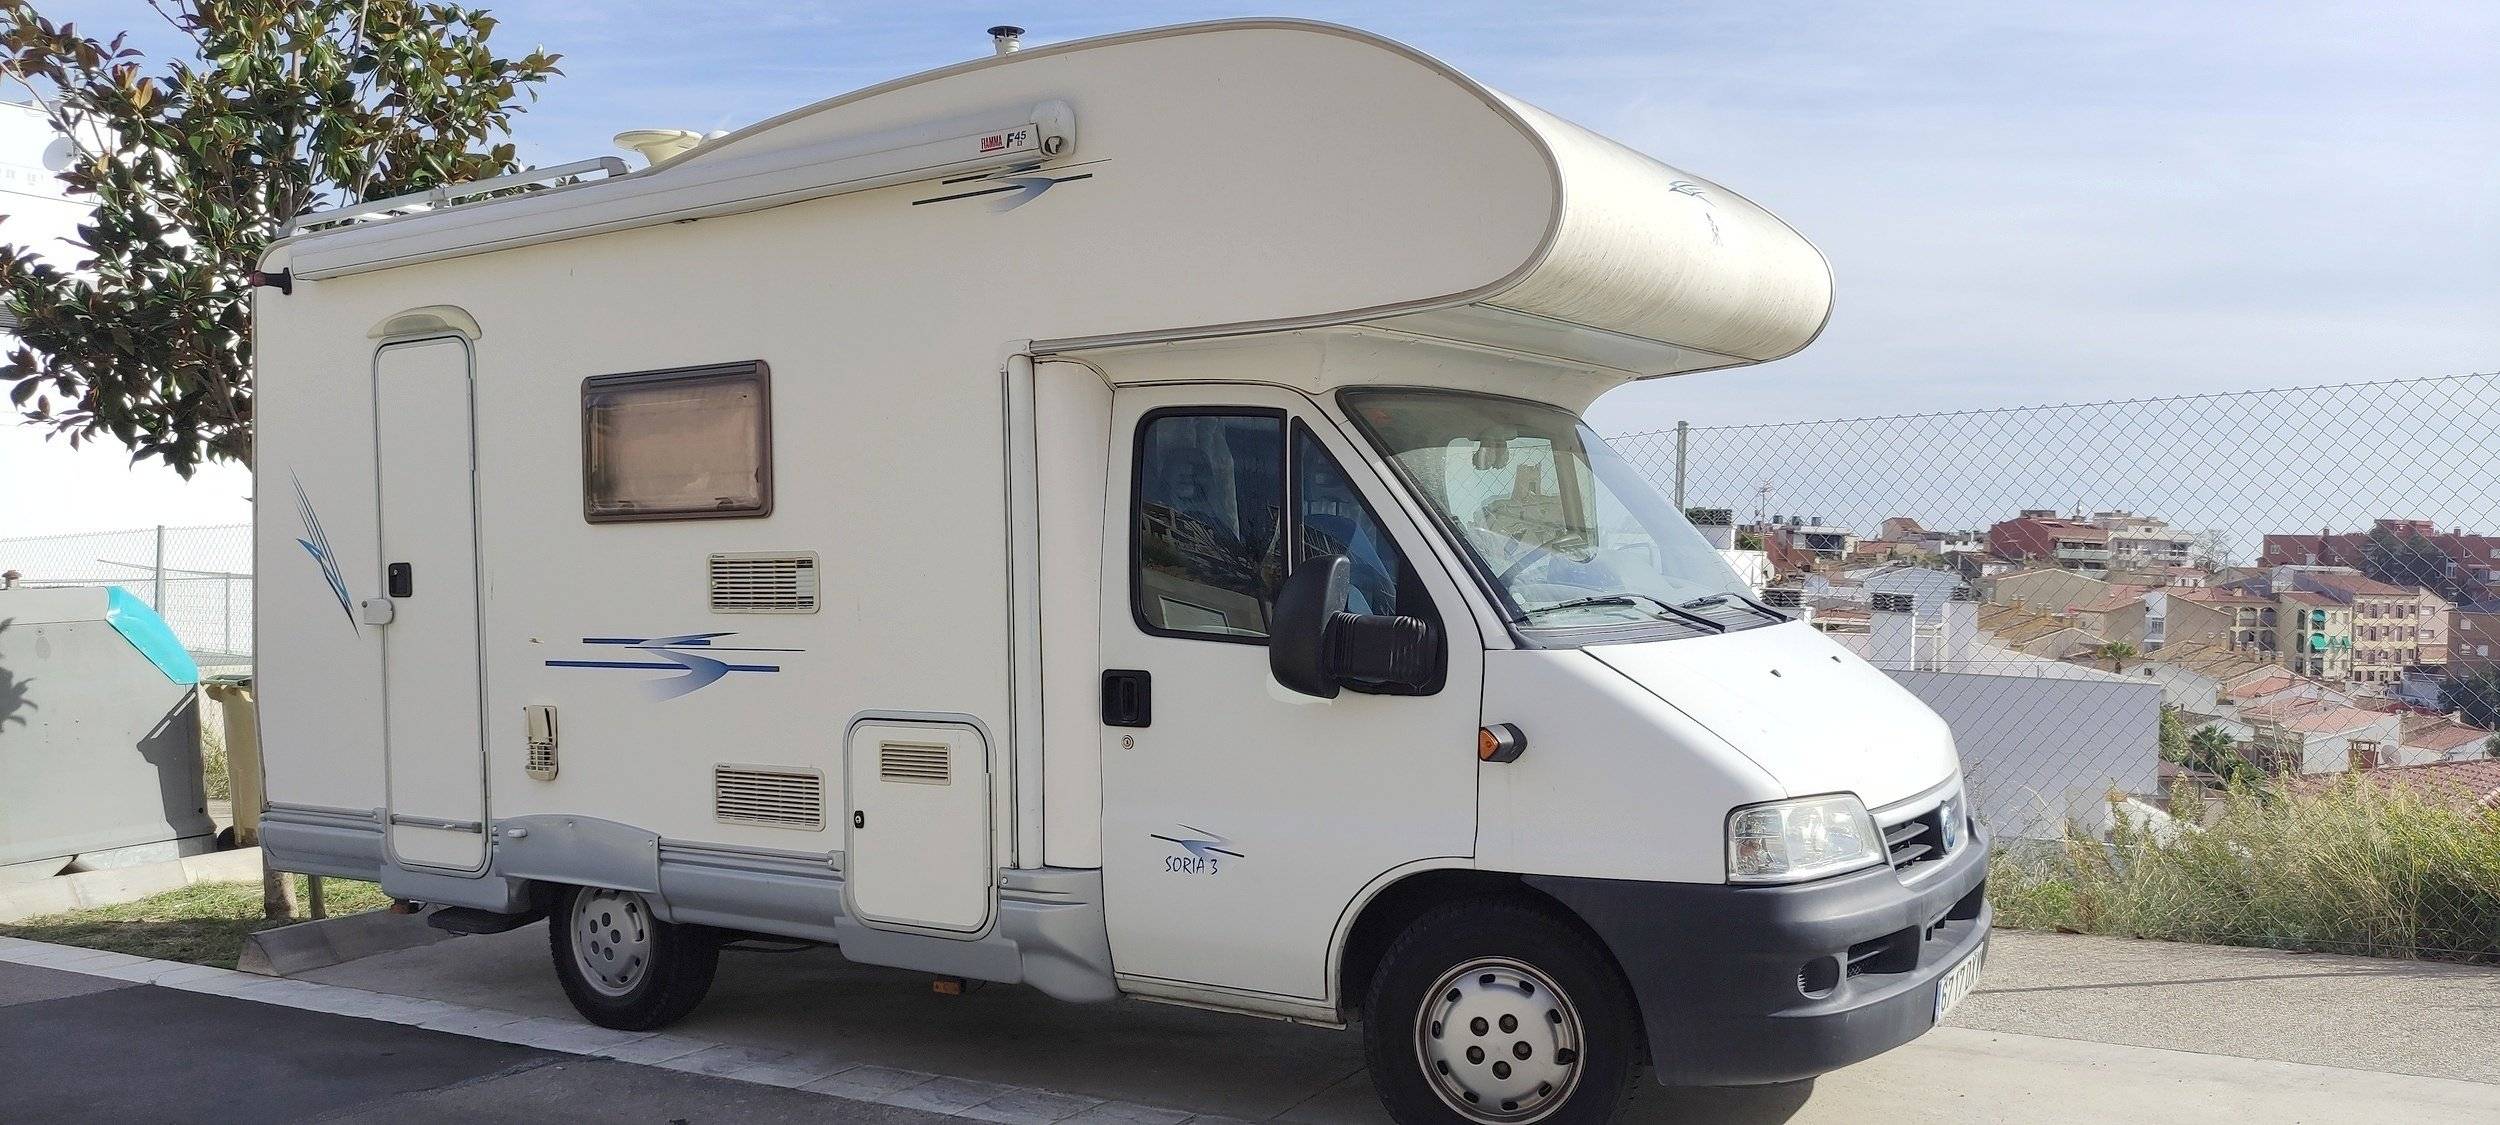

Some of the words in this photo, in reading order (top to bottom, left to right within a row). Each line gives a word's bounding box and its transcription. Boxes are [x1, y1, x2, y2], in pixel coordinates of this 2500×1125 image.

[981, 135, 1003, 150] FIAMMA
[1165, 855, 1205, 874] SORIA
[1210, 858, 1218, 875] 3
